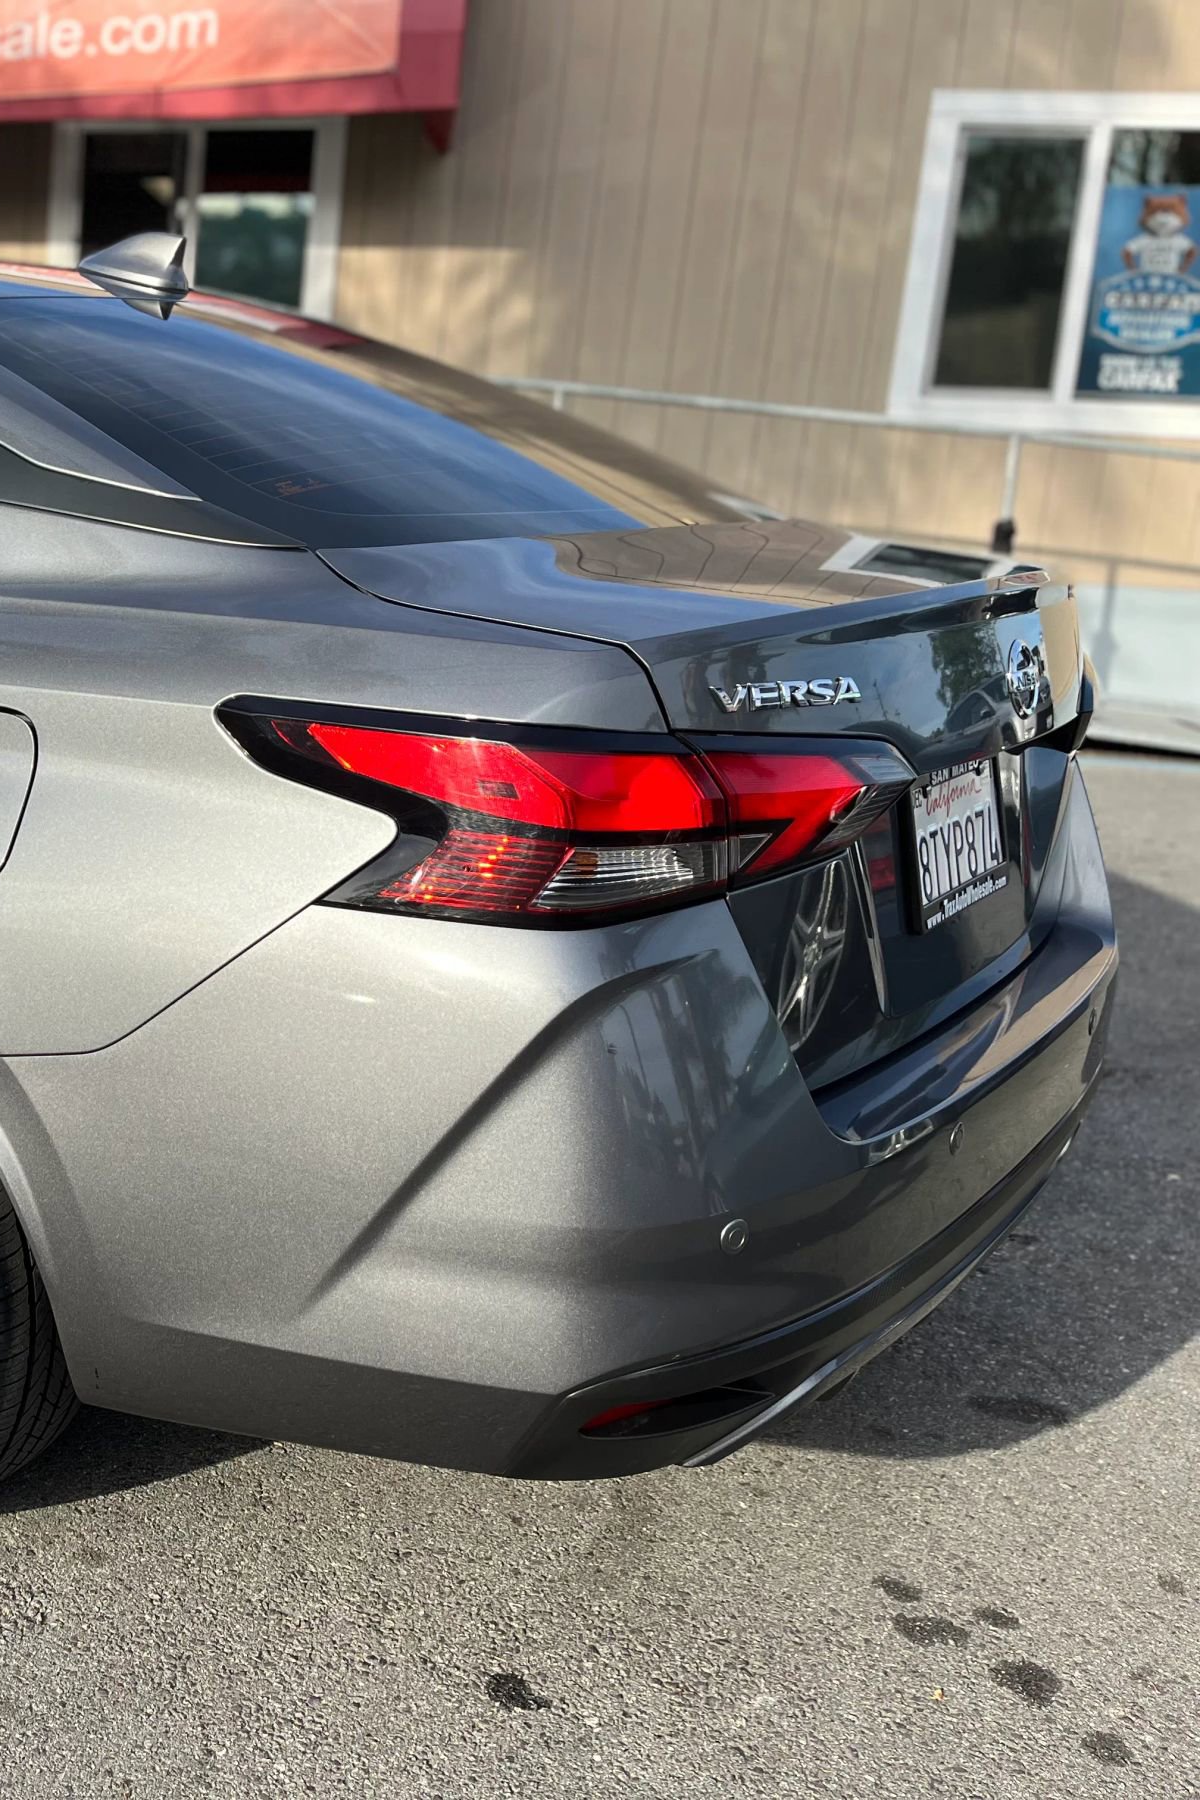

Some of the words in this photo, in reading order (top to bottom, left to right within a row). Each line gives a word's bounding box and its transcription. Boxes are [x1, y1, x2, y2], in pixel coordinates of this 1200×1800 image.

[708, 676, 862, 713] VERSA
[931, 768, 949, 785] SAN
[952, 759, 979, 777] MATEO
[926, 778, 982, 816] California
